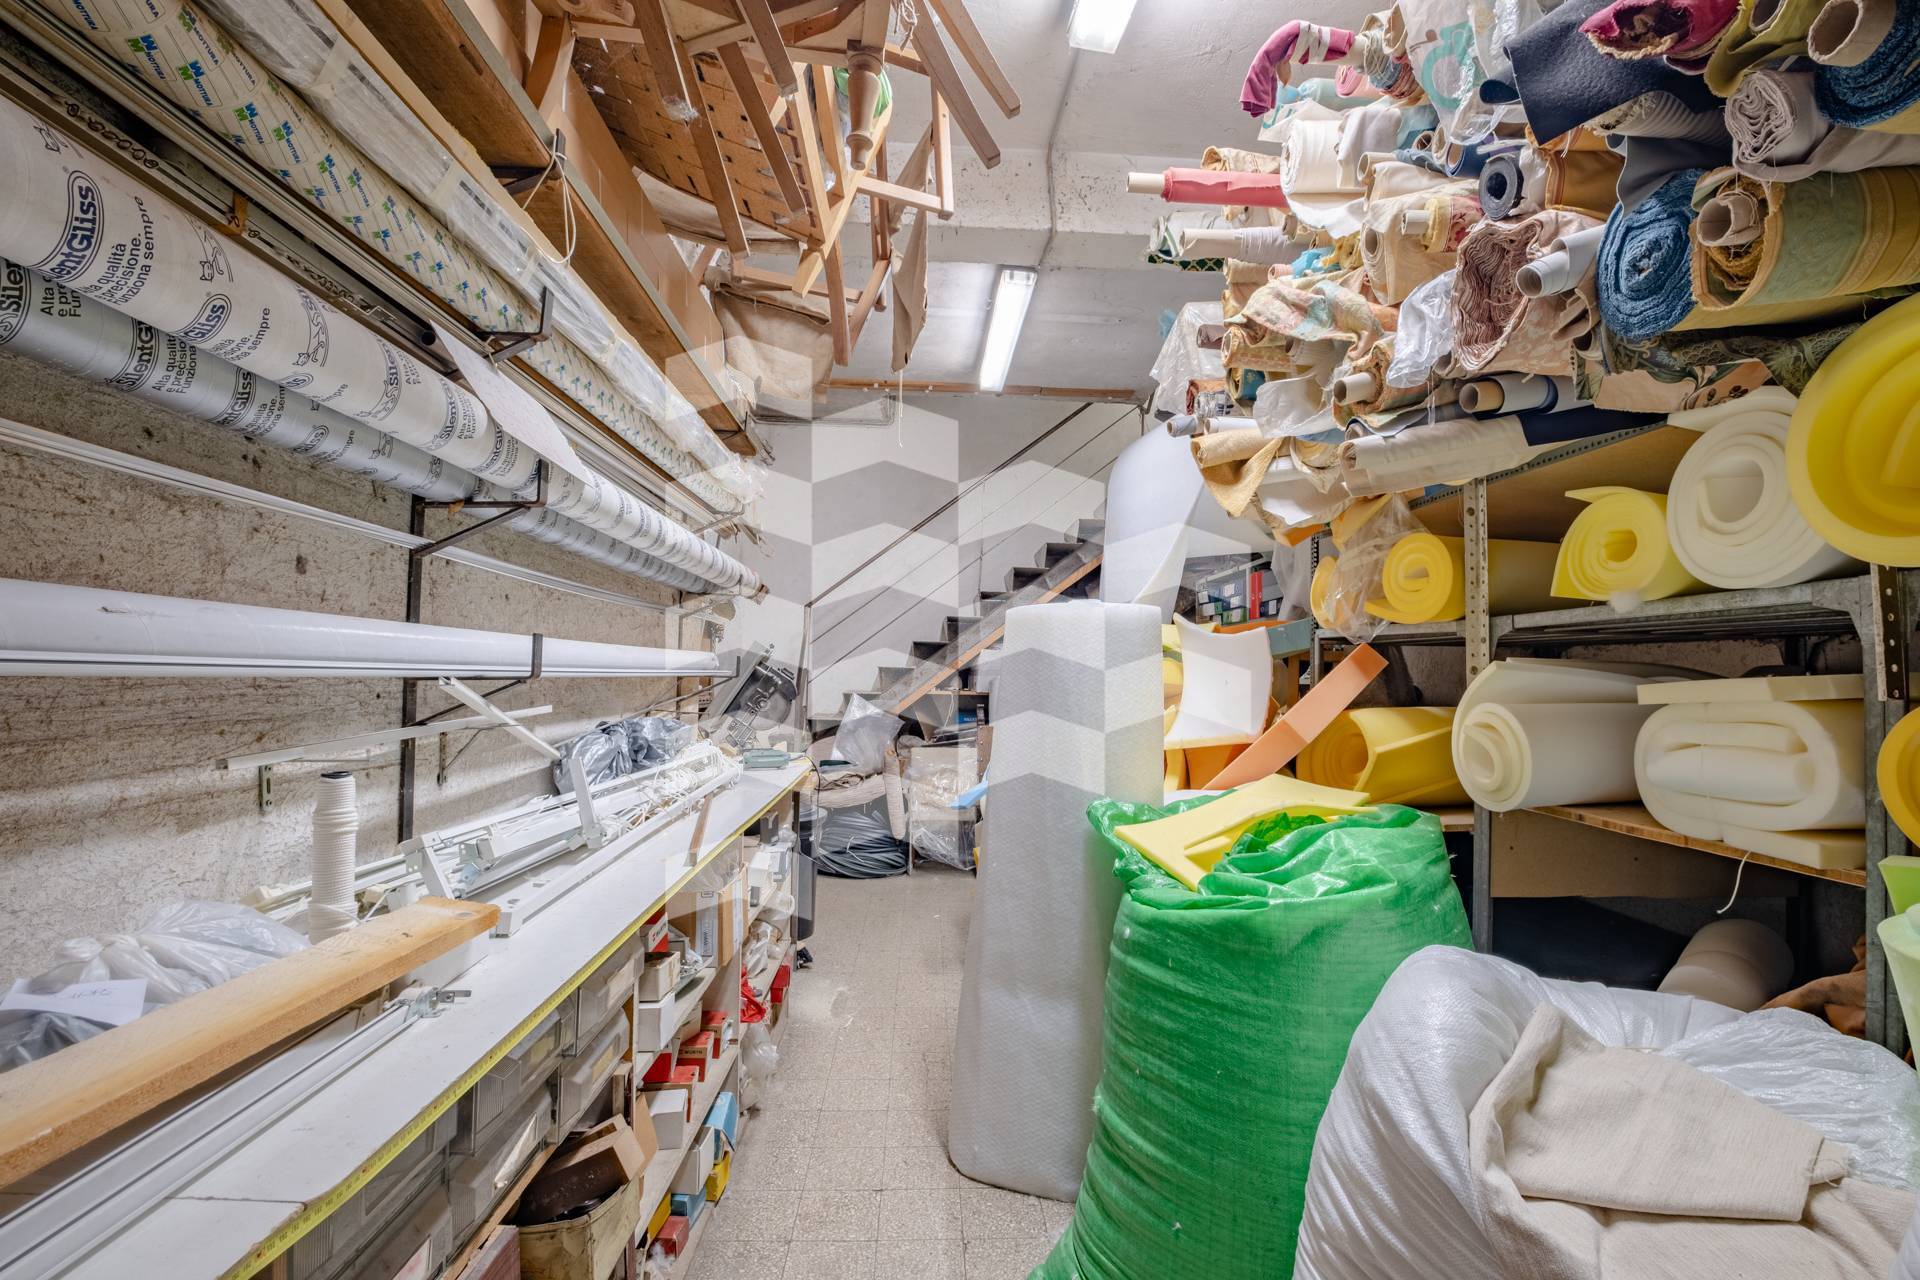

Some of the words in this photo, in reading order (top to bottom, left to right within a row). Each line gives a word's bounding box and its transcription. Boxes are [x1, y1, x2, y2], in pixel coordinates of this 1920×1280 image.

[134, 196, 154, 260] sempre
[41, 287, 54, 316] Alta
[152, 374, 171, 391] Alta
[166, 335, 177, 372] qualit
